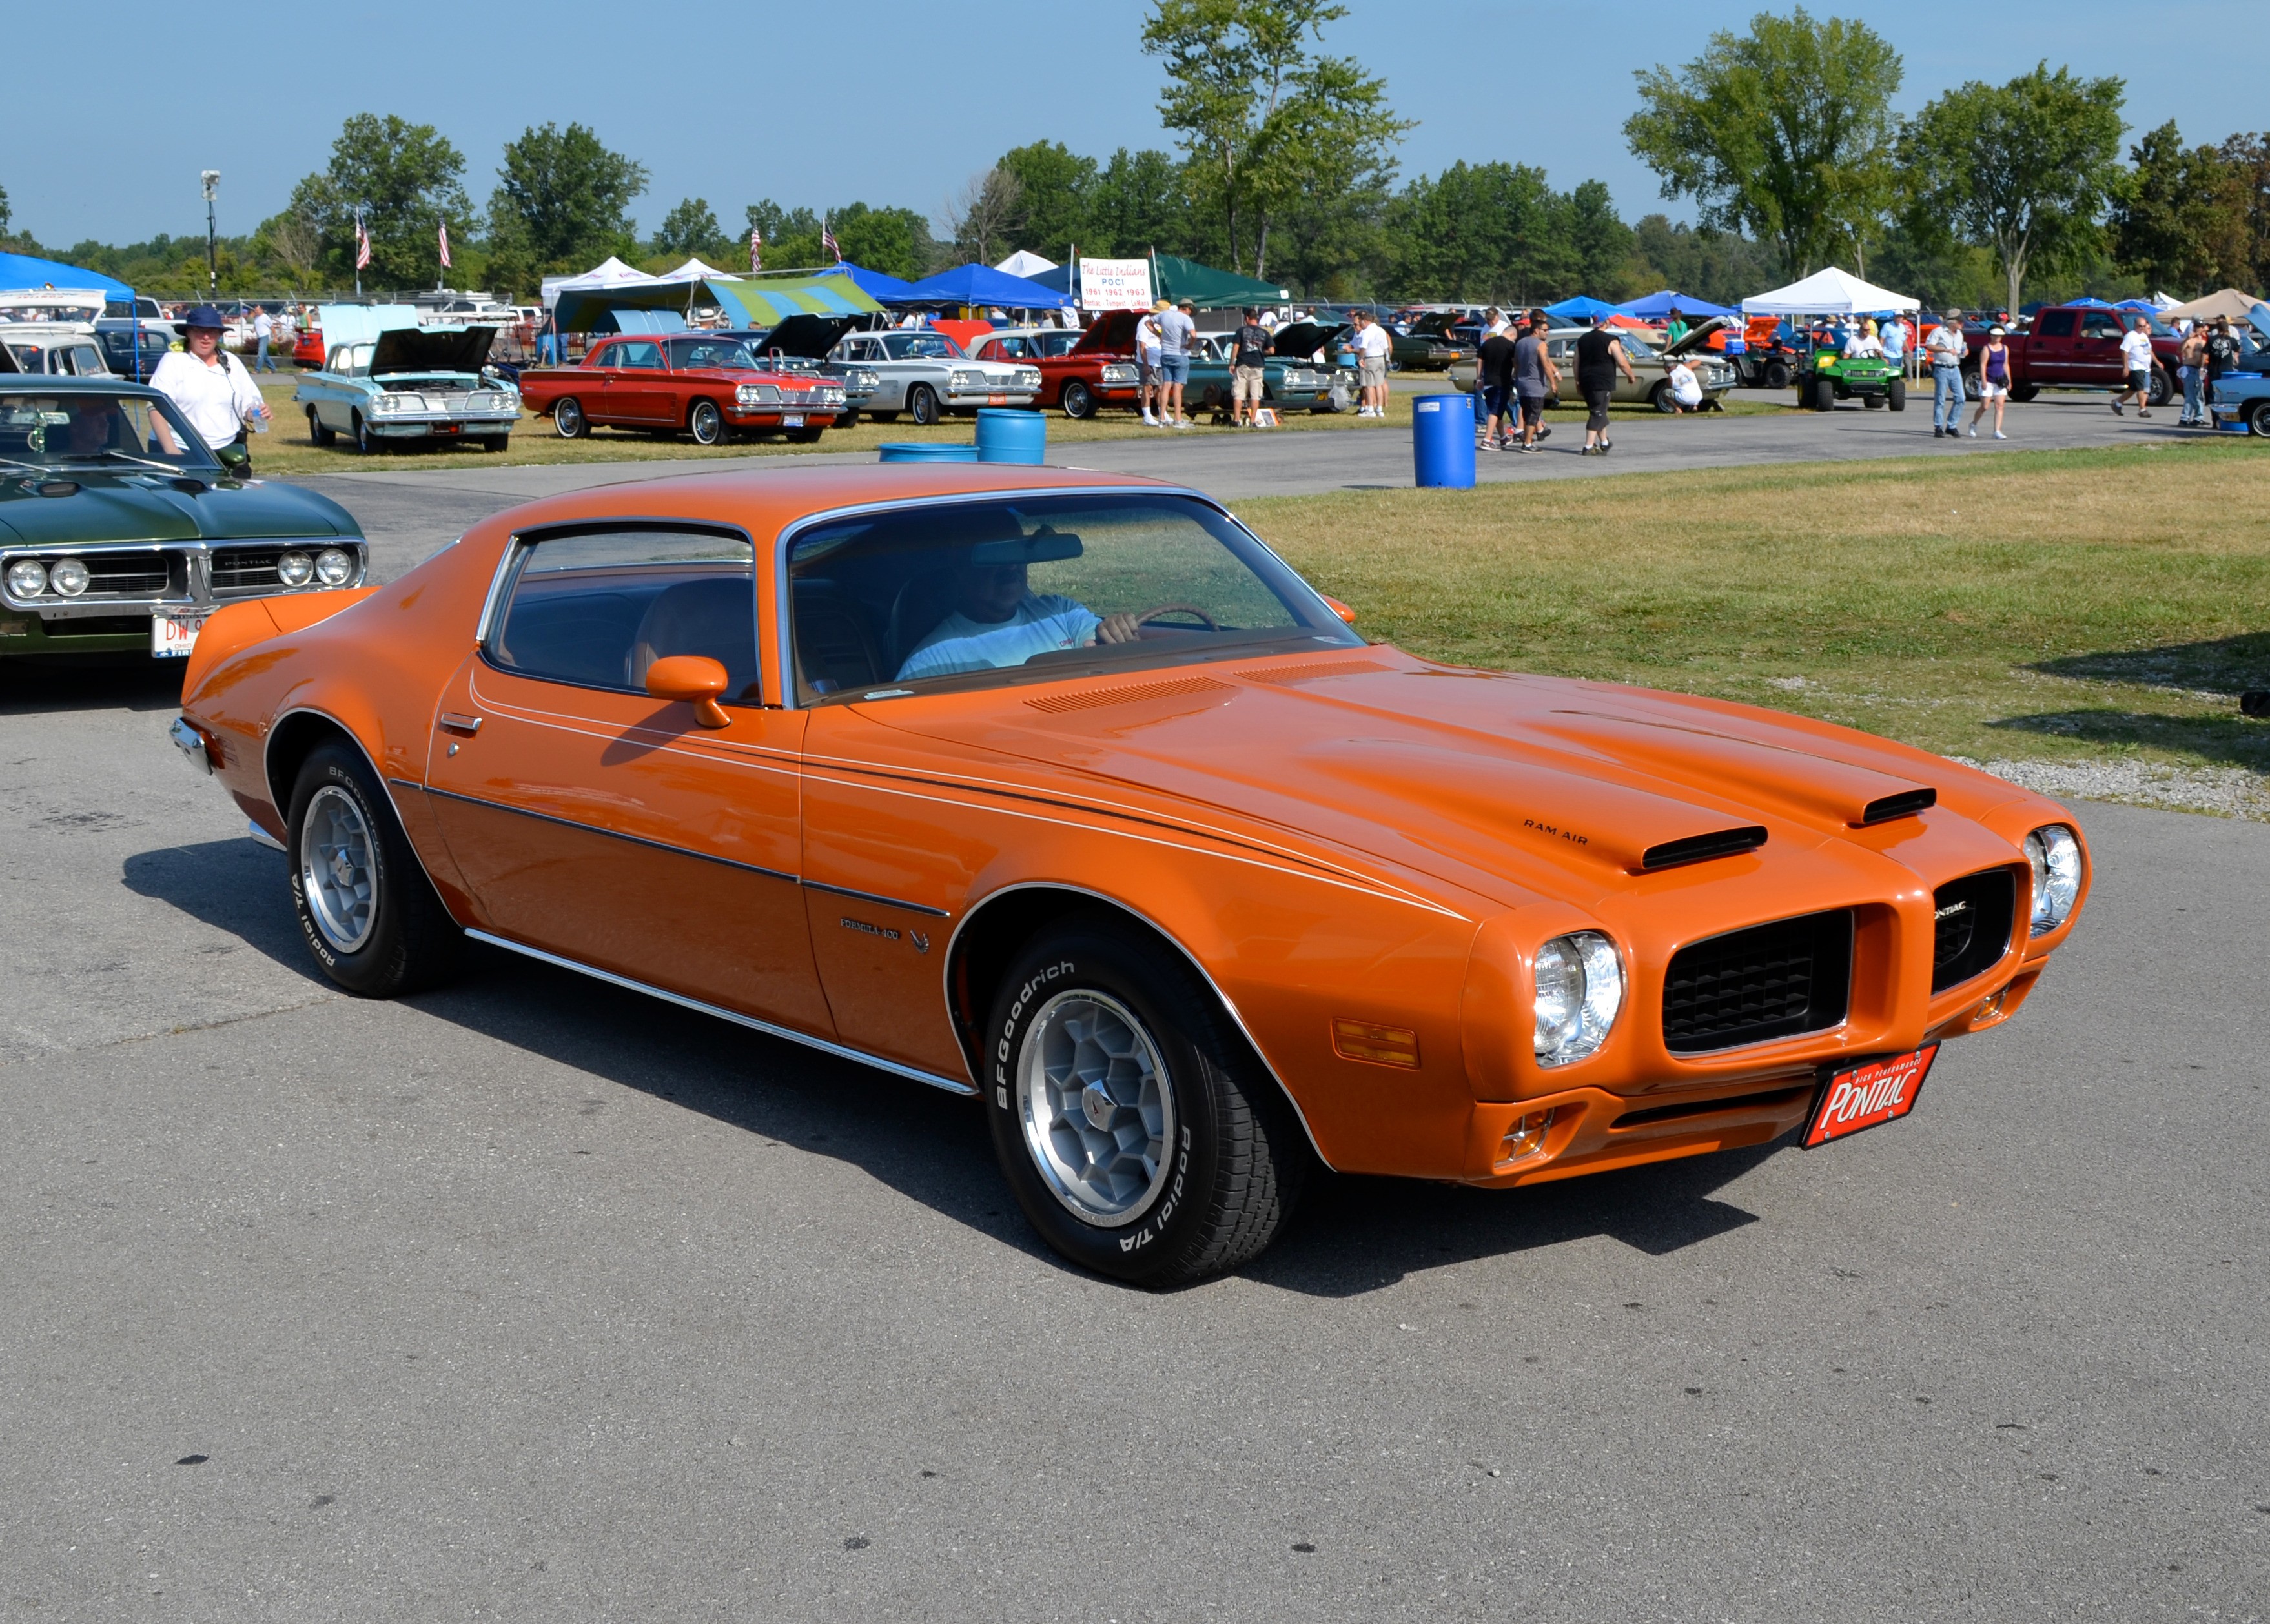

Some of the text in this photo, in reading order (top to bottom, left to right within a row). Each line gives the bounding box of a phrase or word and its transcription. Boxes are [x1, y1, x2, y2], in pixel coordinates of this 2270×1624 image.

[1082, 262, 1146, 276] The Little Indians
[1106, 299, 1126, 309] Tempest
[166, 620, 189, 641] DW
[1524, 819, 1588, 846] RAM AIR
[291, 873, 336, 967] Radial T/A
[881, 929, 899, 940] 400
[997, 961, 1074, 1110] BFGoodrich
[1855, 1057, 1922, 1084] HIGH PERFORMANCE
[1819, 1068, 1918, 1130] PONTIAC
[1120, 1124, 1191, 1252] Radial T/A
